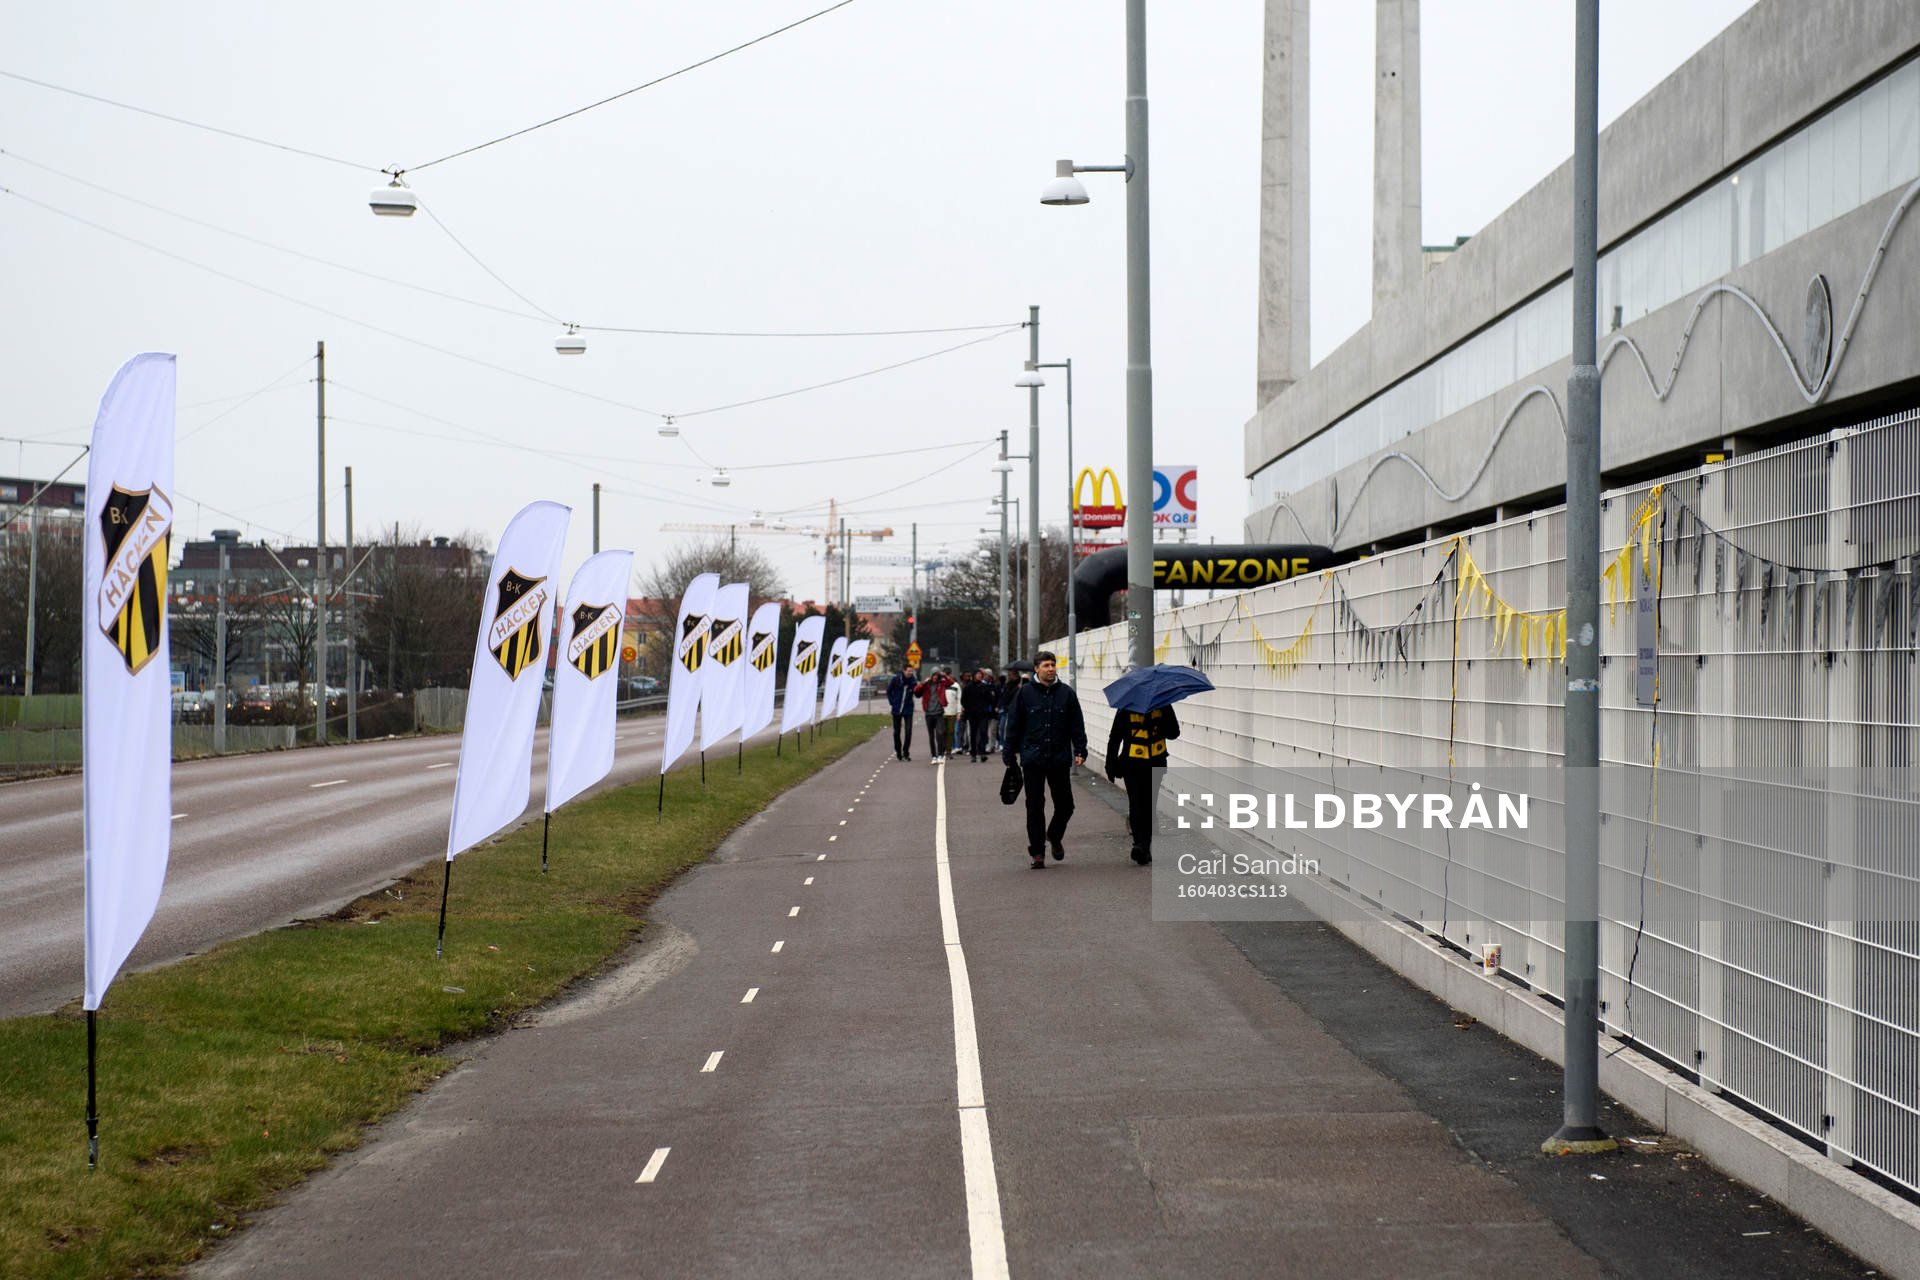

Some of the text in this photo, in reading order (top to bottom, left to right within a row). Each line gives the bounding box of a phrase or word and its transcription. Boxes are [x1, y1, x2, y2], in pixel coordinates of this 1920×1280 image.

[1073, 513, 1123, 521] MDonald's
[1172, 513, 1190, 523] Q8
[495, 587, 548, 640] HÄCKEN
[573, 612, 617, 654] HÄCKEN
